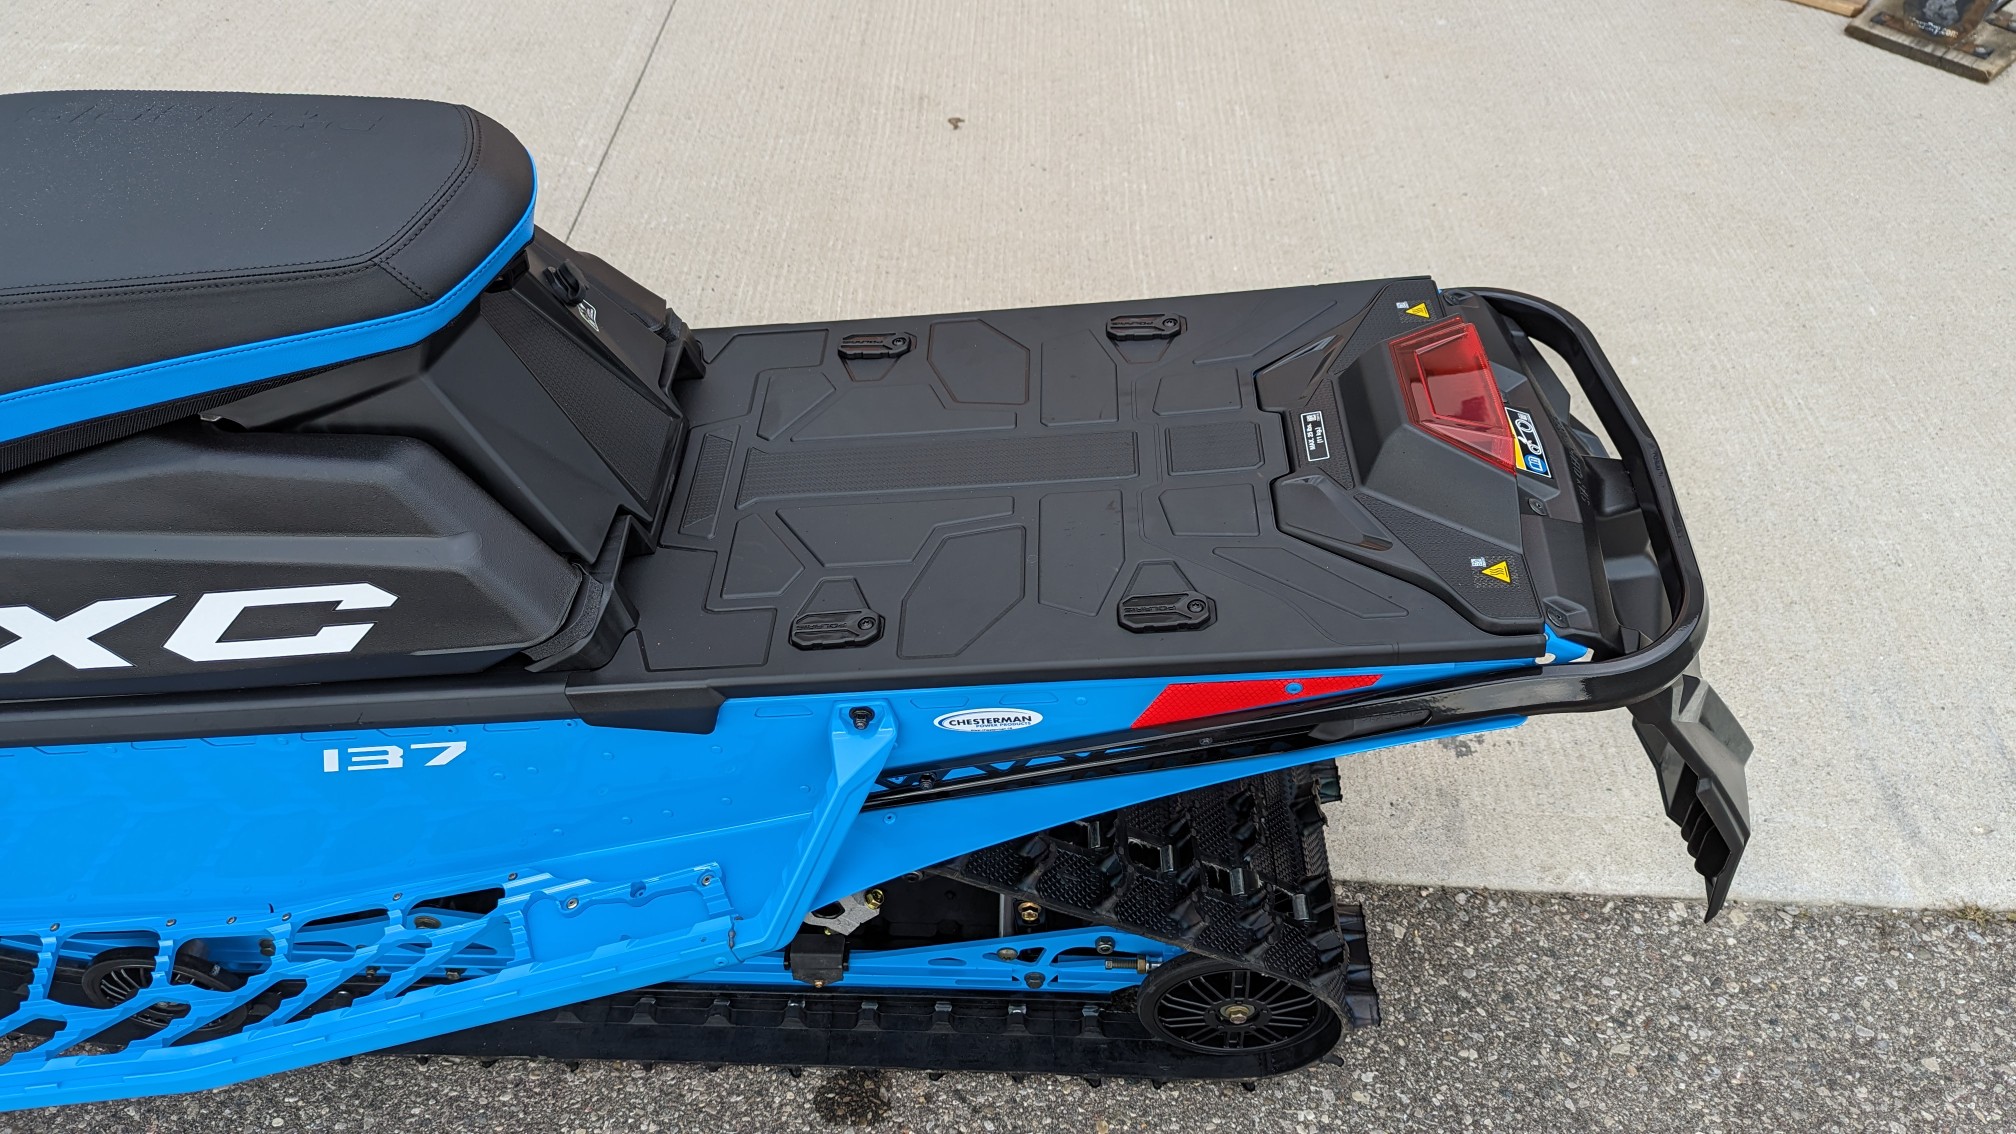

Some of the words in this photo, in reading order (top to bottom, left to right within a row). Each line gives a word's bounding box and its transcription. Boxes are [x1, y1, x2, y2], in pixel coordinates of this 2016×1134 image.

[1123, 605, 1177, 613] POLARIS
[796, 623, 847, 631] POLARIS
[949, 715, 1032, 726] CHESTERMAN
[323, 741, 467, 773] 137
